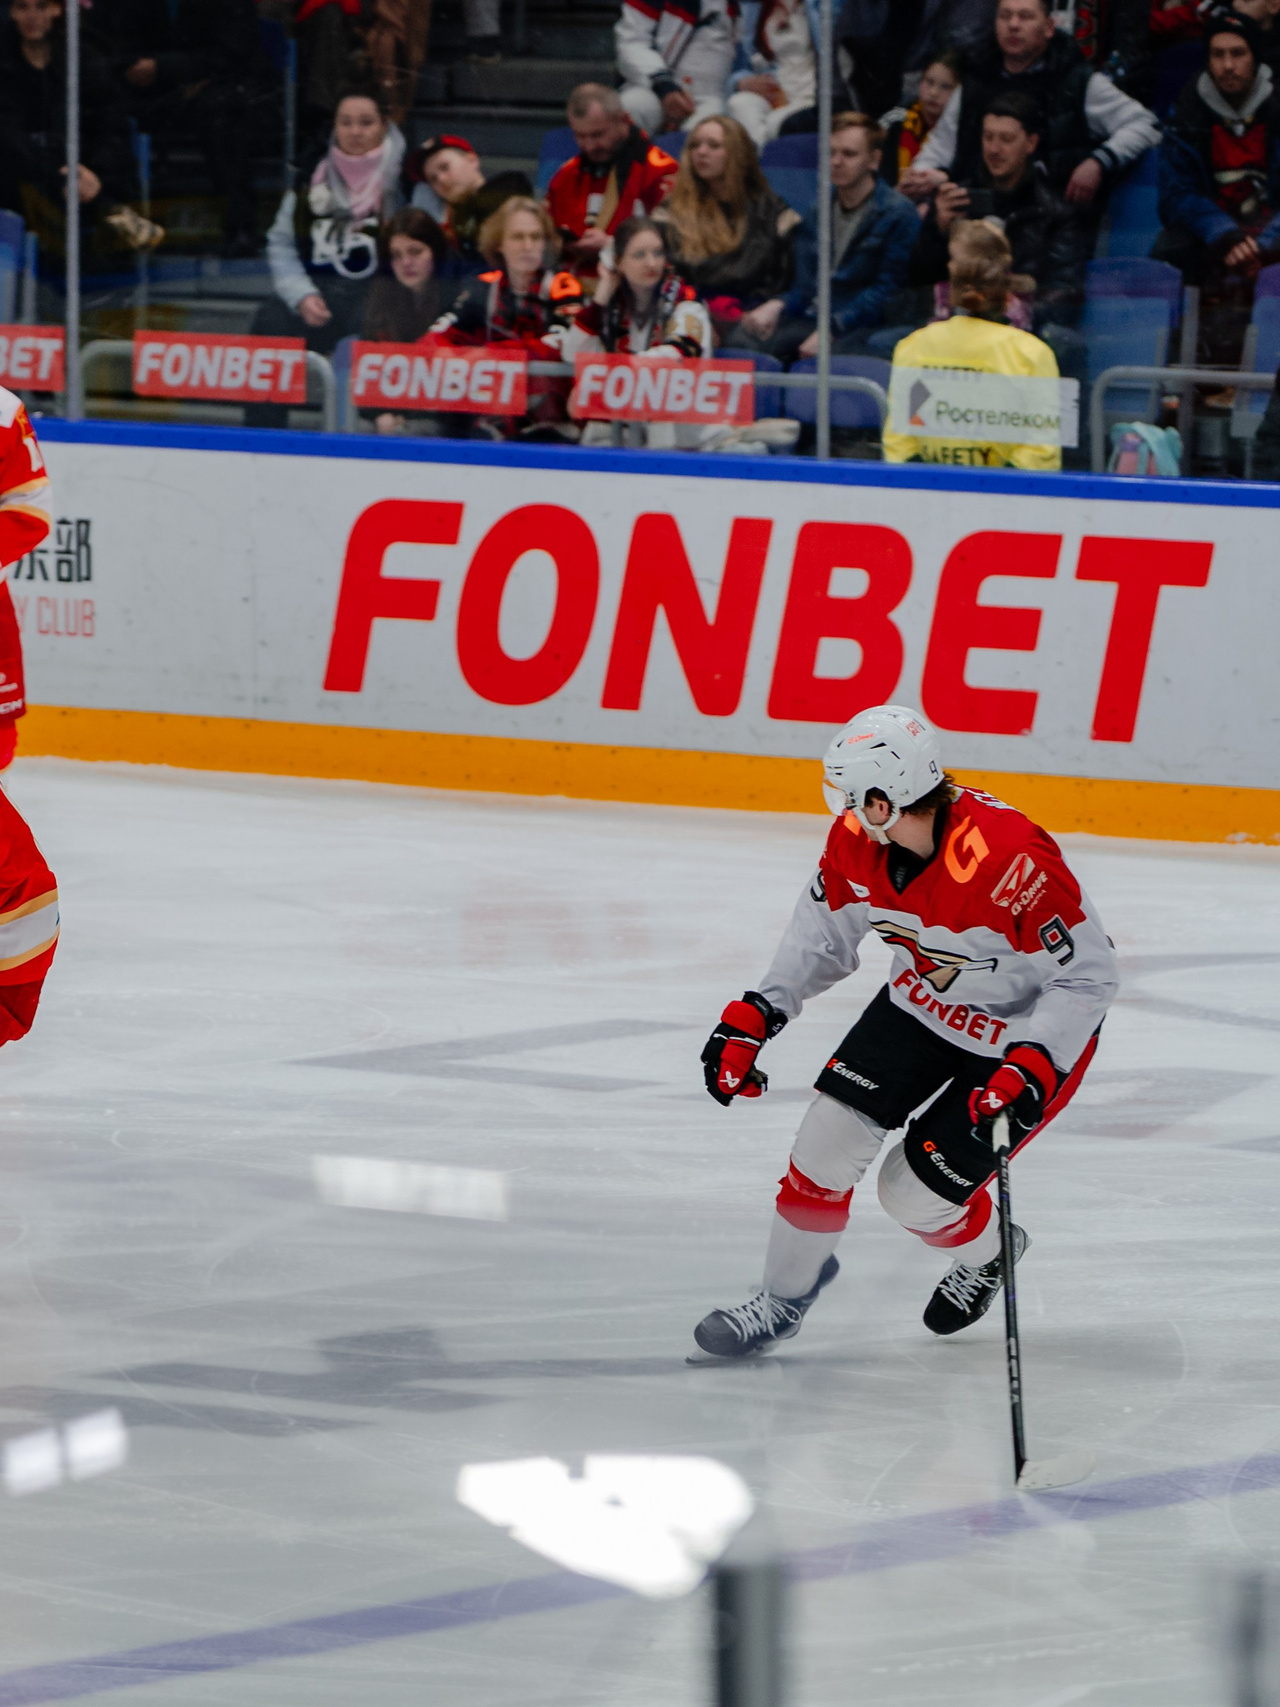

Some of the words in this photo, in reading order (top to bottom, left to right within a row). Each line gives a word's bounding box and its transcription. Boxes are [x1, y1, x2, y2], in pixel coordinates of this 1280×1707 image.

[135, 341, 304, 392] FONBET
[353, 352, 525, 404] FONBET
[577, 363, 753, 416] FONBET
[935, 400, 1062, 430] Ростелеком
[37, 596, 96, 638] CLUB
[322, 497, 1216, 744] FONBET
[1037, 913, 1075, 967] 9
